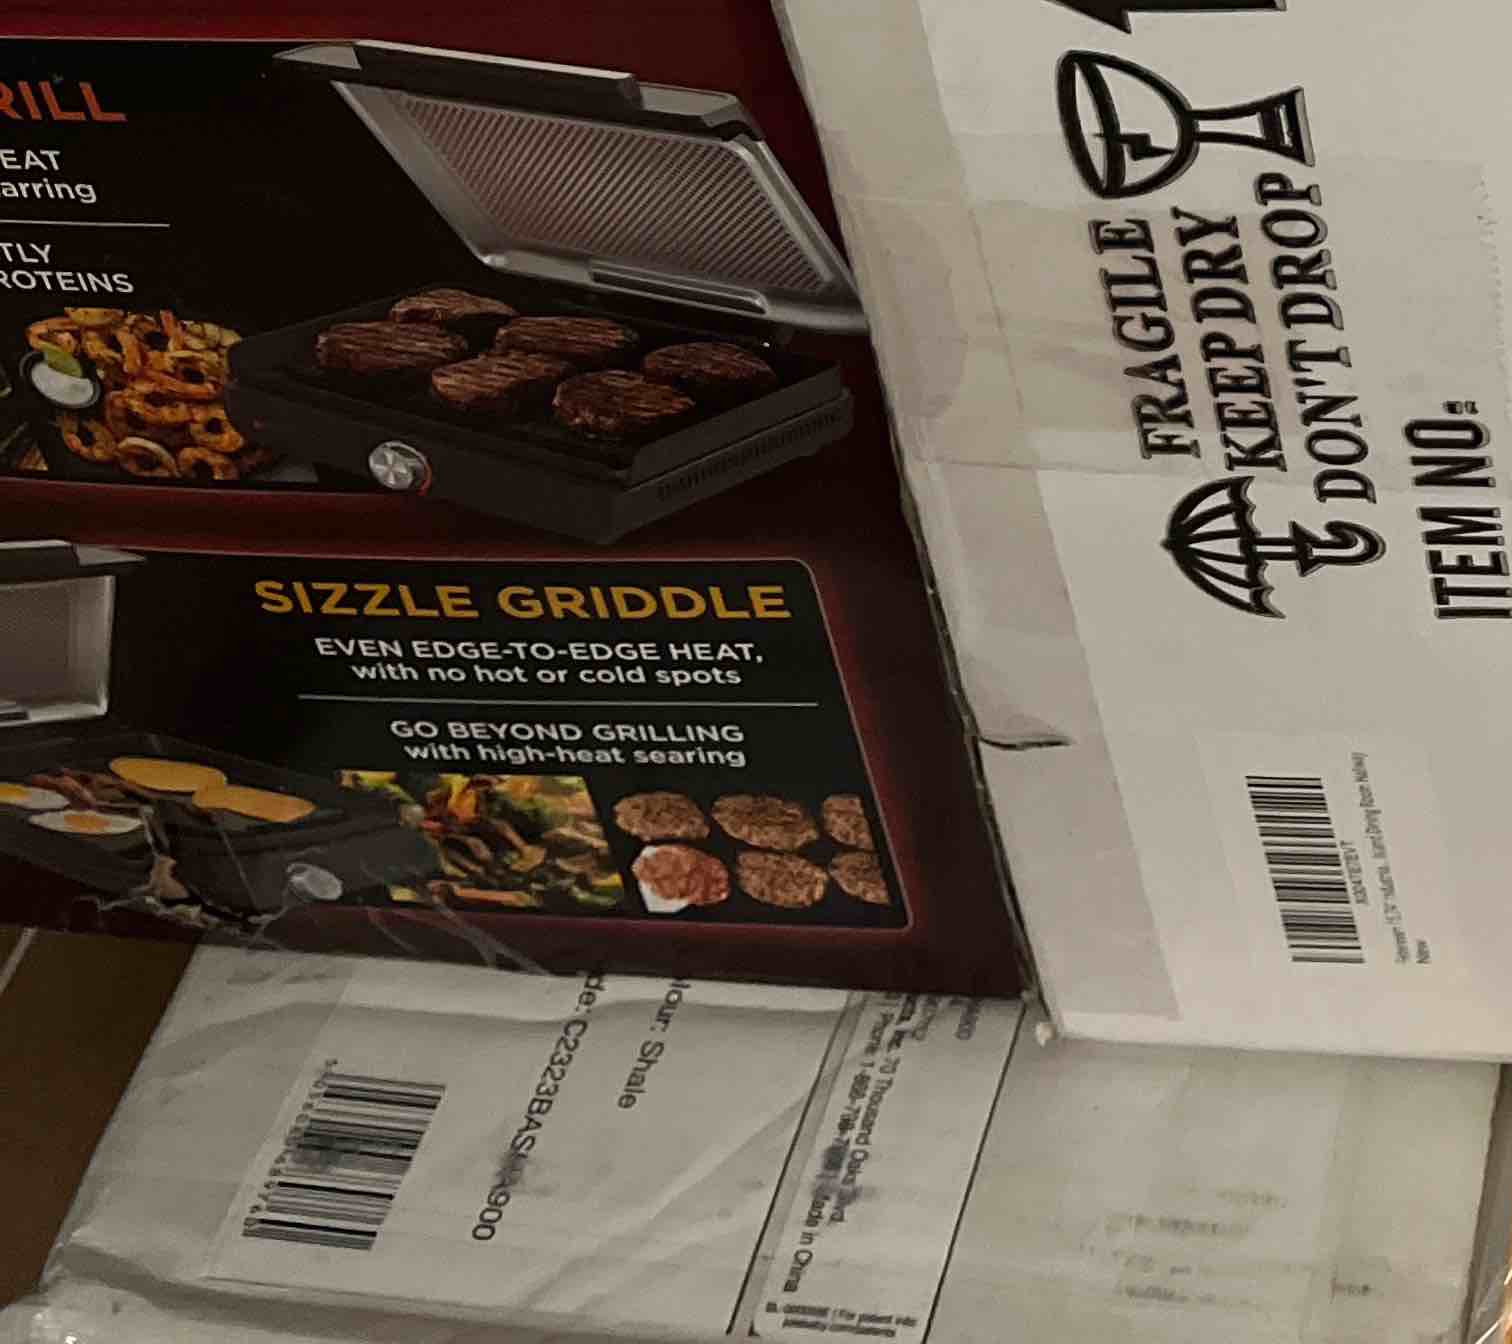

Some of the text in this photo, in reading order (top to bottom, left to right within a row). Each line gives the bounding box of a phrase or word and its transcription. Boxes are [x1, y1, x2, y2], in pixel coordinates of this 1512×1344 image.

[1, 177, 97, 204] arring
[1091, 217, 1202, 461] FRAGILE
[1171, 204, 1289, 474] KEEP DRY
[1254, 170, 1377, 506] DON'T DROP
[1403, 398, 1498, 489] NO:
[255, 580, 792, 620] SIZZLE GRIDDLE
[315, 637, 764, 664] EVEN EDGE-TO-EDGE HEAT,
[351, 660, 742, 687] with no hot or cold spots
[389, 719, 746, 744] GO BEYOND GRILLING
[403, 742, 748, 768] with high-heat searing
[617, 1039, 666, 1110] Shale
[854, 1077, 894, 1147] Thousand
[783, 1247, 814, 1293] China
